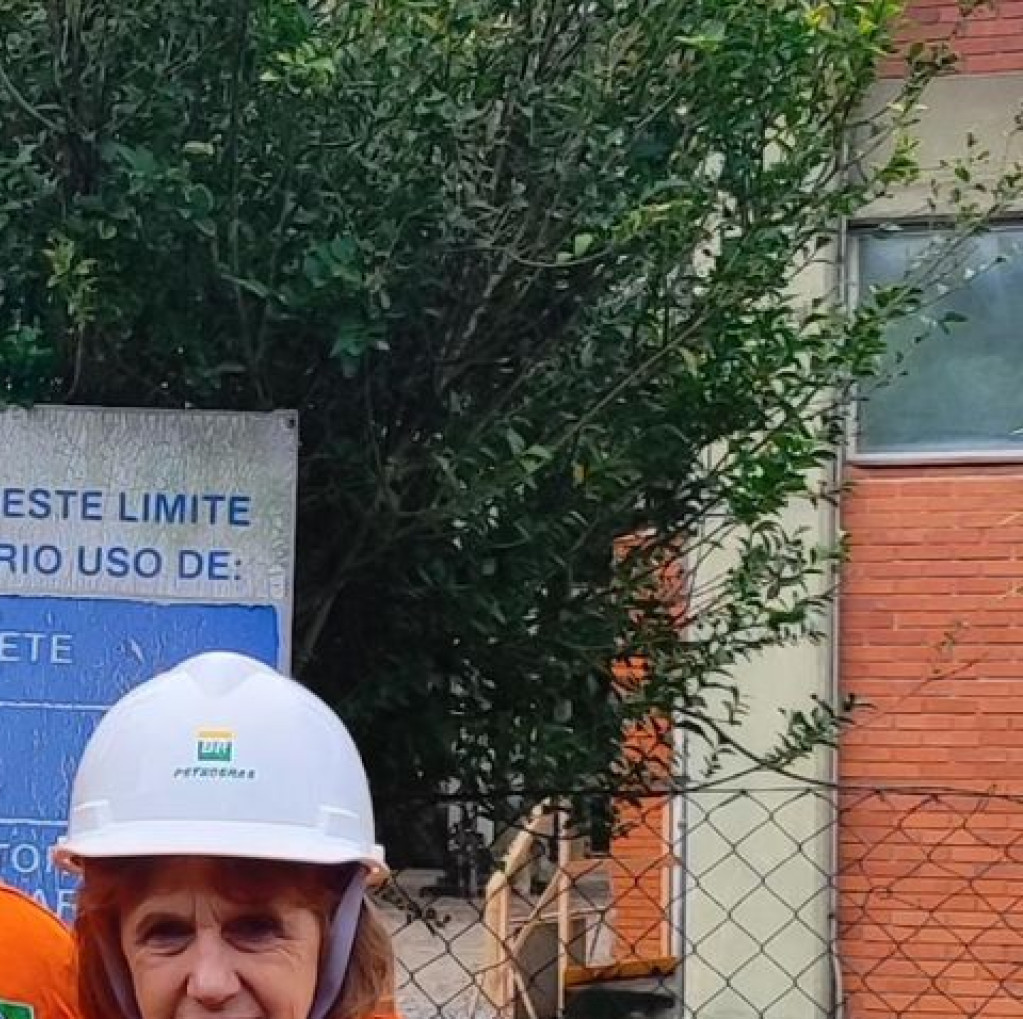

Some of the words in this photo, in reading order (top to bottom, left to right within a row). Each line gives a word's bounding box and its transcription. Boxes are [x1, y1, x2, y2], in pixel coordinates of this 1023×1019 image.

[118, 490, 252, 527] LIMITE
[76, 546, 163, 580] USO
[178, 549, 243, 582] DE:
